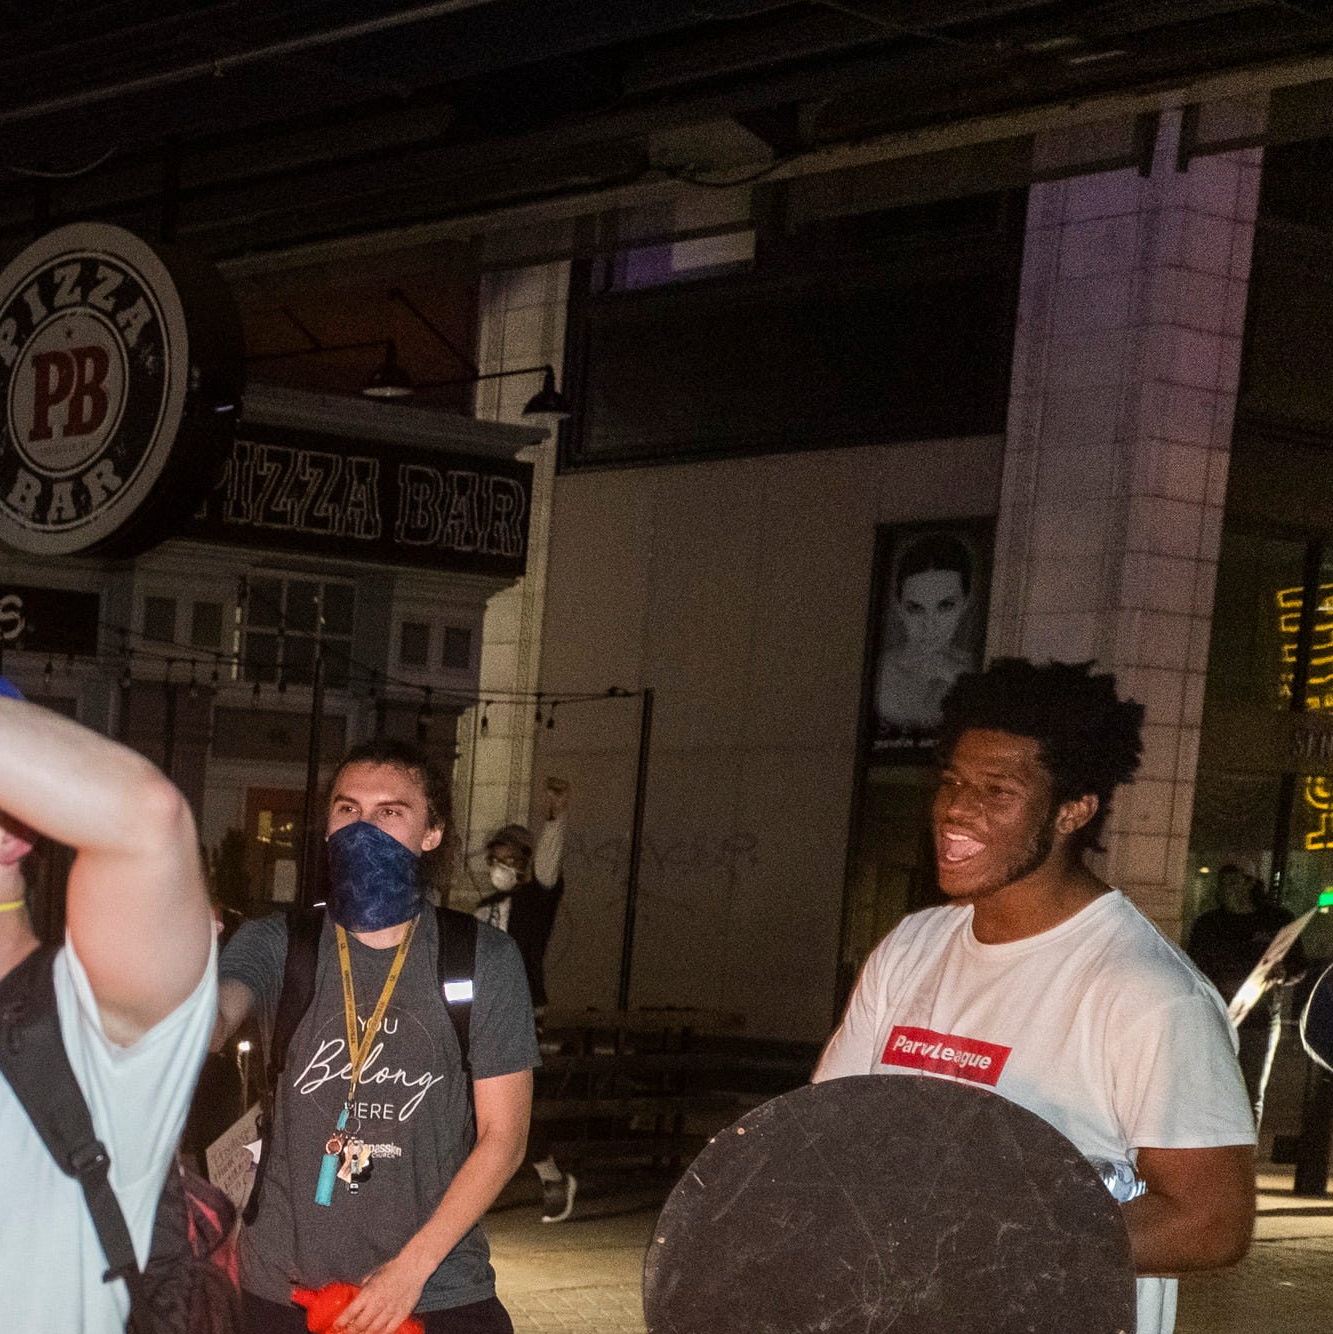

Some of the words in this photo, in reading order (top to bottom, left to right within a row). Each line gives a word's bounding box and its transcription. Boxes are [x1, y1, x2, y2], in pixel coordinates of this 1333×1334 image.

[28, 345, 110, 443] PB
[6, 457, 123, 525] BAR
[395, 463, 526, 557] BAR
[357, 1015, 399, 1035] YOU
[293, 1038, 445, 1122] Belong
